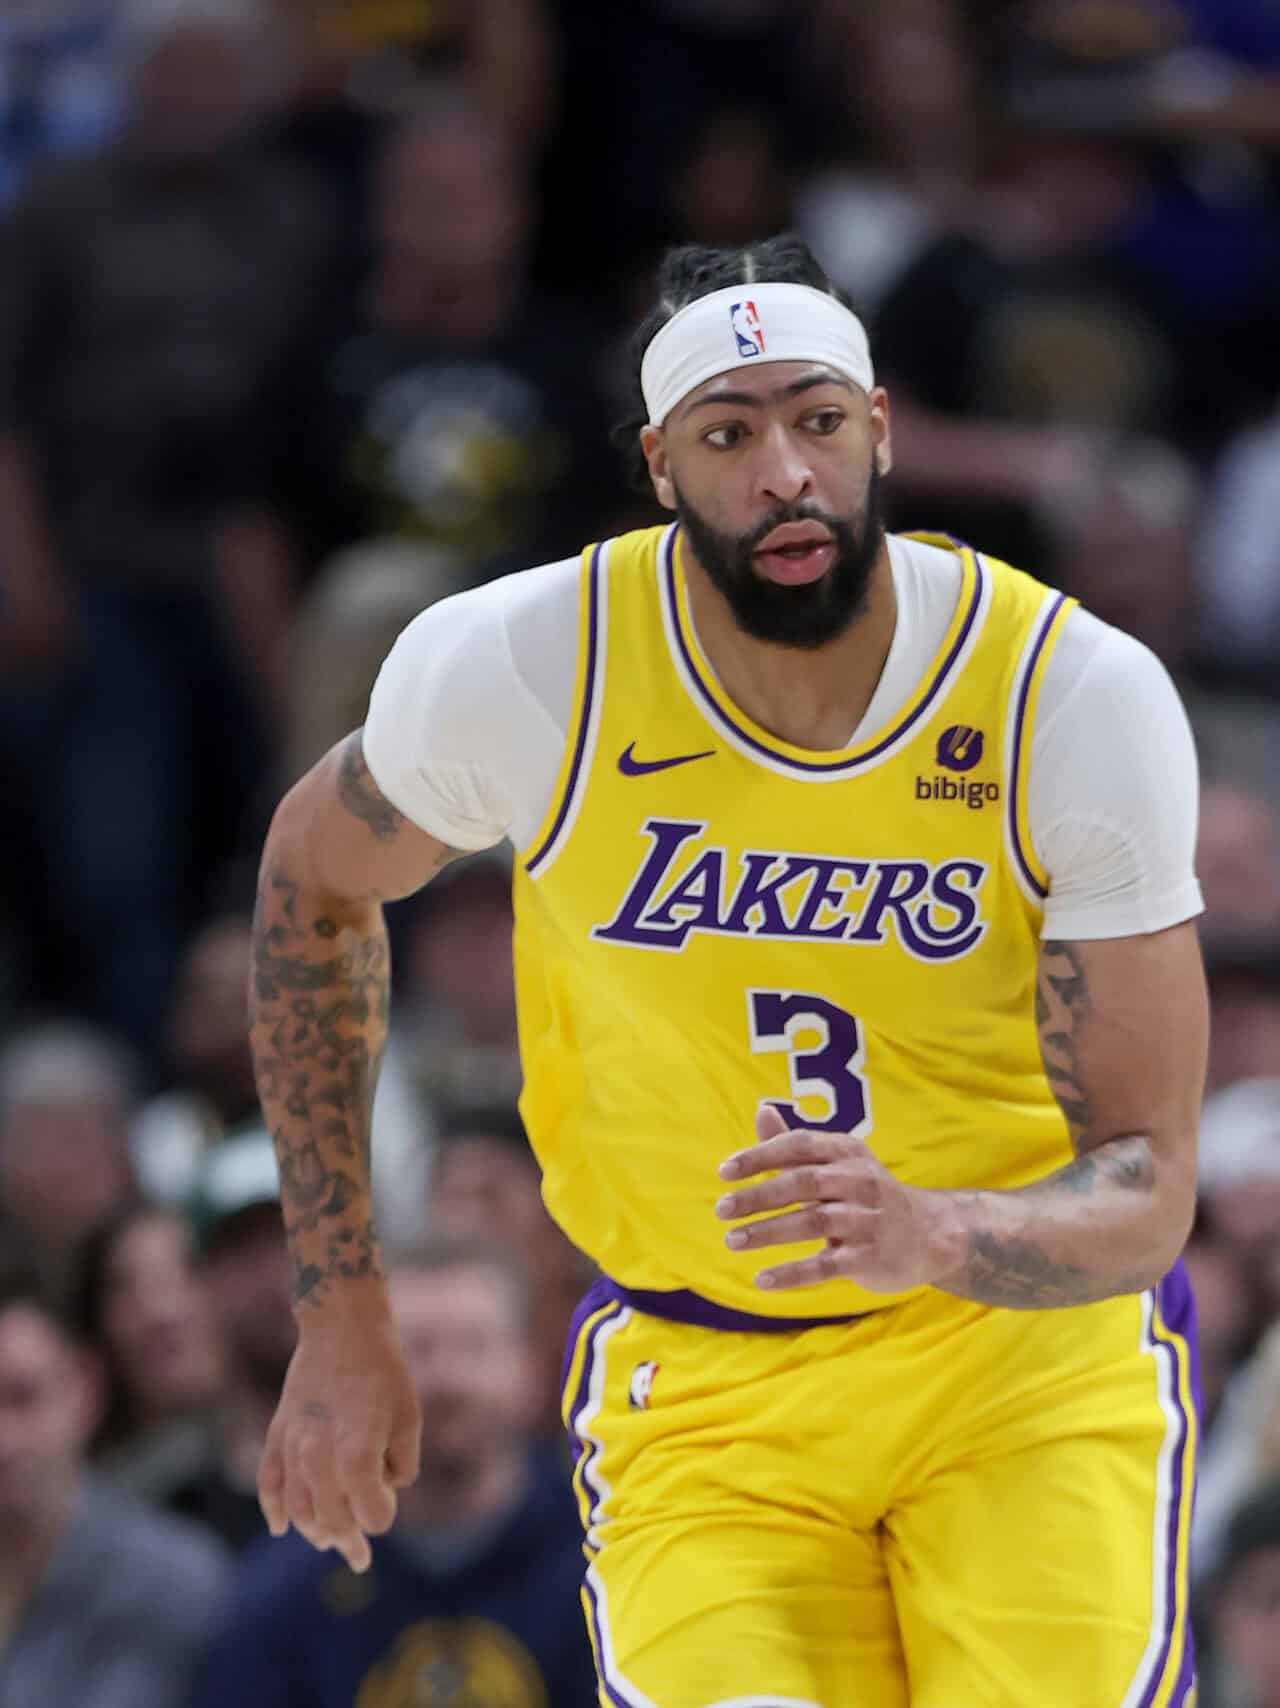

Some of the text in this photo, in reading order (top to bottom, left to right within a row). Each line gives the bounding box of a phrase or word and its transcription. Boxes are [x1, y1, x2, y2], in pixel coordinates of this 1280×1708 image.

[916, 776, 998, 809] bibigo
[592, 816, 988, 962] LAKERS
[745, 987, 873, 1138] 3
